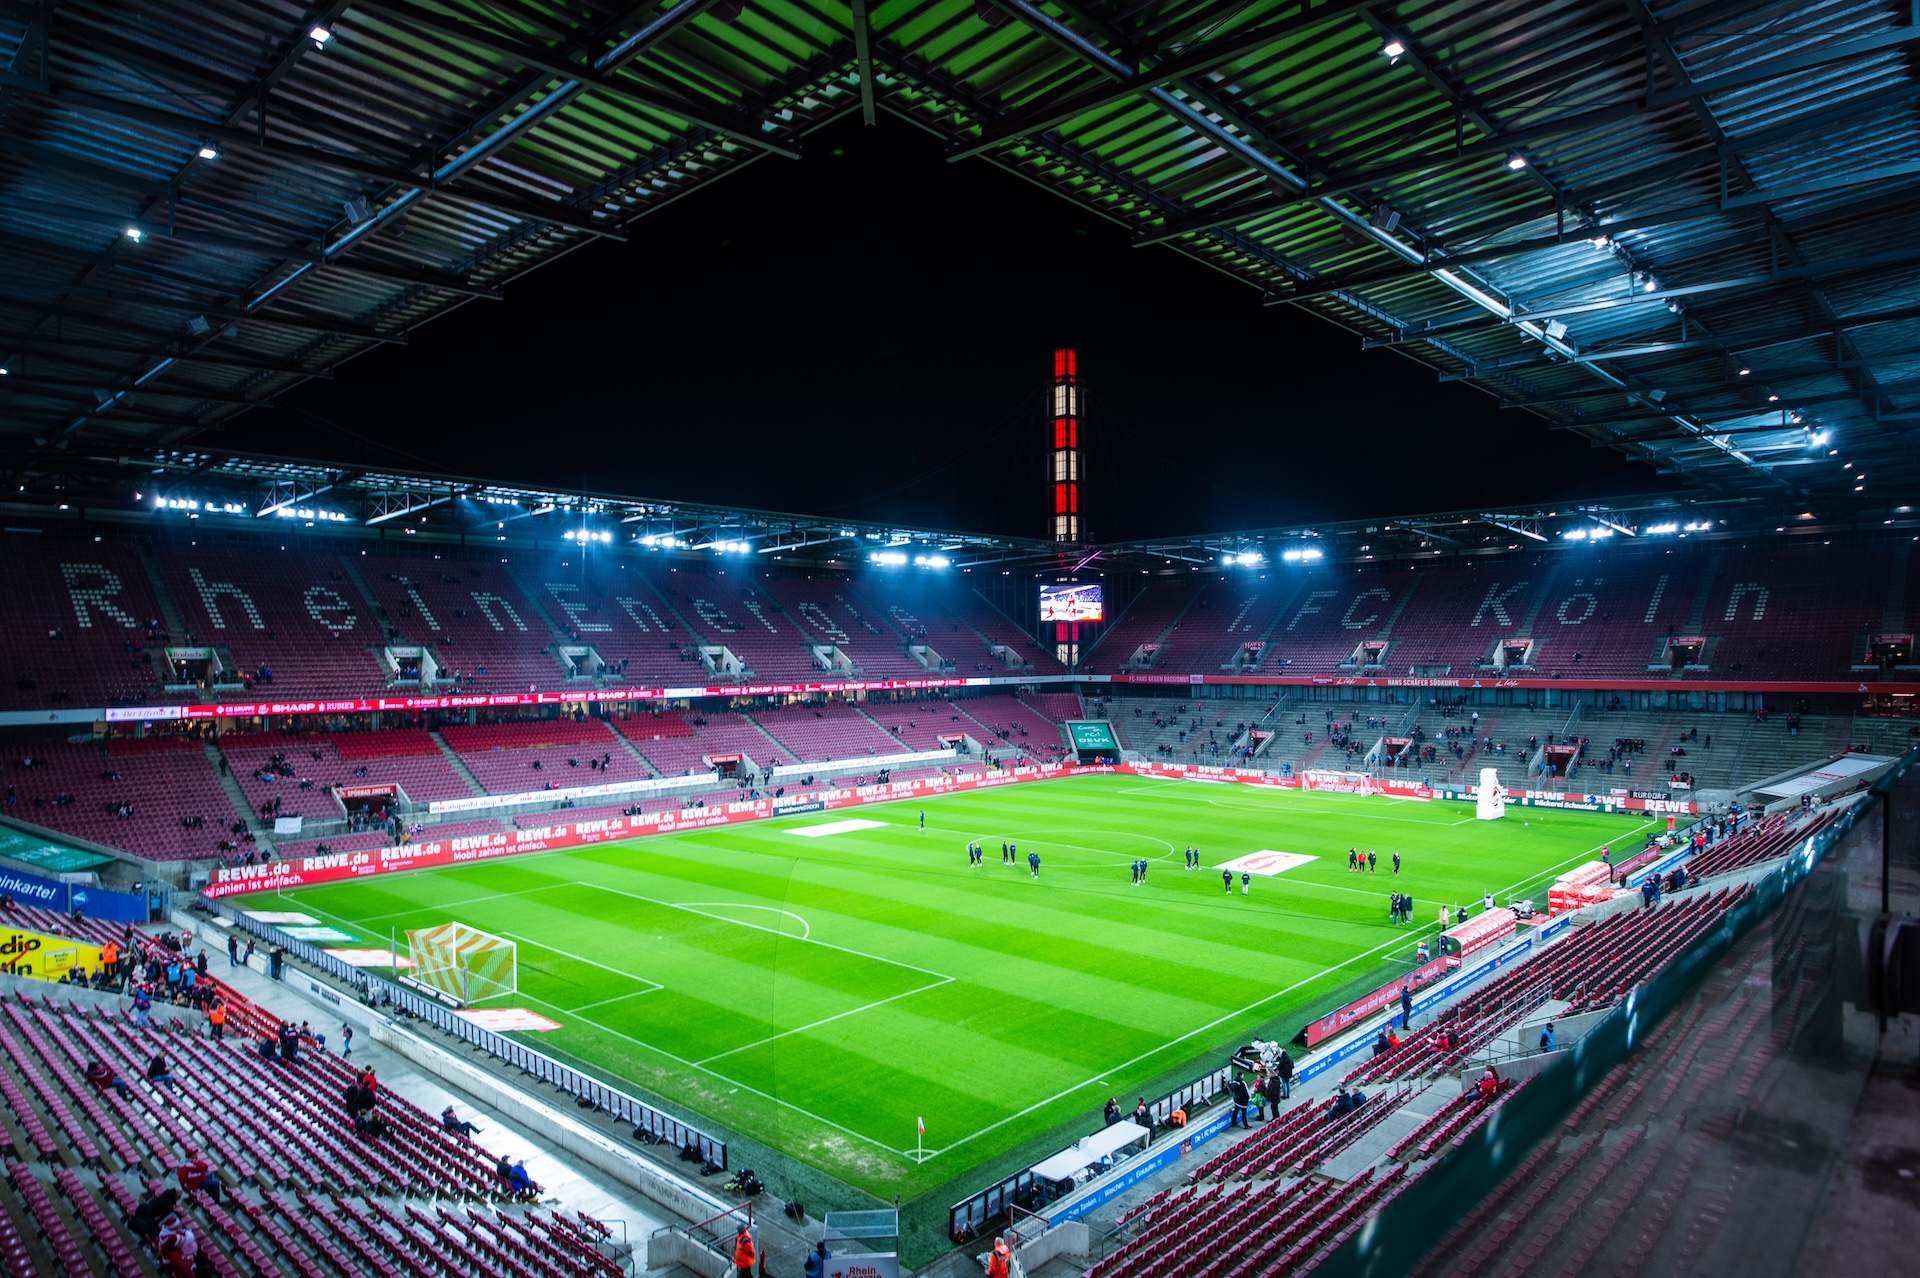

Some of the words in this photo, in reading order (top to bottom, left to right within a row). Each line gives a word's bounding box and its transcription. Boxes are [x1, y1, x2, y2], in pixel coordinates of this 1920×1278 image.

[1286, 588, 1391, 631] FC
[1470, 575, 1770, 627] Köln
[1129, 675, 1148, 683] FC-FANS
[1148, 675, 1163, 683] GEGEN
[1163, 675, 1190, 683] RASSISMUS
[1403, 678, 1429, 686] SCHÄFER
[271, 703, 315, 713] SHARP
[451, 697, 487, 705] SHARP
[956, 772, 982, 784] REWE.de
[986, 769, 1011, 780] REWE.de
[892, 779, 921, 792] REWE.de
[925, 776, 953, 788] REWE.de
[818, 788, 852, 801] REWE.de
[856, 783, 887, 797] REWE.de
[1457, 793, 1479, 801] Bäcker
[1526, 789, 1565, 801] REWE
[772, 794, 808, 808] REWE.de
[863, 794, 876, 803] Mobil
[1534, 799, 1562, 808] Bäckerei
[1564, 801, 1599, 811] Schneider
[682, 806, 722, 821] REWE.de
[729, 799, 767, 815] REWE.de
[1645, 799, 1690, 814] REWE
[576, 818, 623, 835] REWE.de
[631, 811, 674, 828] REWE.de
[657, 821, 675, 832] Mobil
[676, 818, 696, 830] zahlen
[697, 818, 705, 827] ist
[706, 815, 729, 826] einfach.
[517, 826, 568, 843] REWE.de
[452, 834, 507, 852] REWE.de
[381, 842, 441, 861] REWE.de
[453, 848, 477, 861] Mobil
[479, 845, 505, 858] zahlen
[506, 843, 517, 853] ist
[518, 840, 548, 852] einfach.
[303, 851, 369, 871] REWE.de
[218, 862, 291, 882] REWE.de
[203, 886, 215, 898] bil
[216, 881, 246, 896] zahlen
[249, 876, 262, 890] ist
[264, 874, 304, 888] einfach.
[1367, 995, 1378, 1010] sind
[1378, 992, 1386, 1004] wir
[849, 1265, 877, 1276] Rhein
